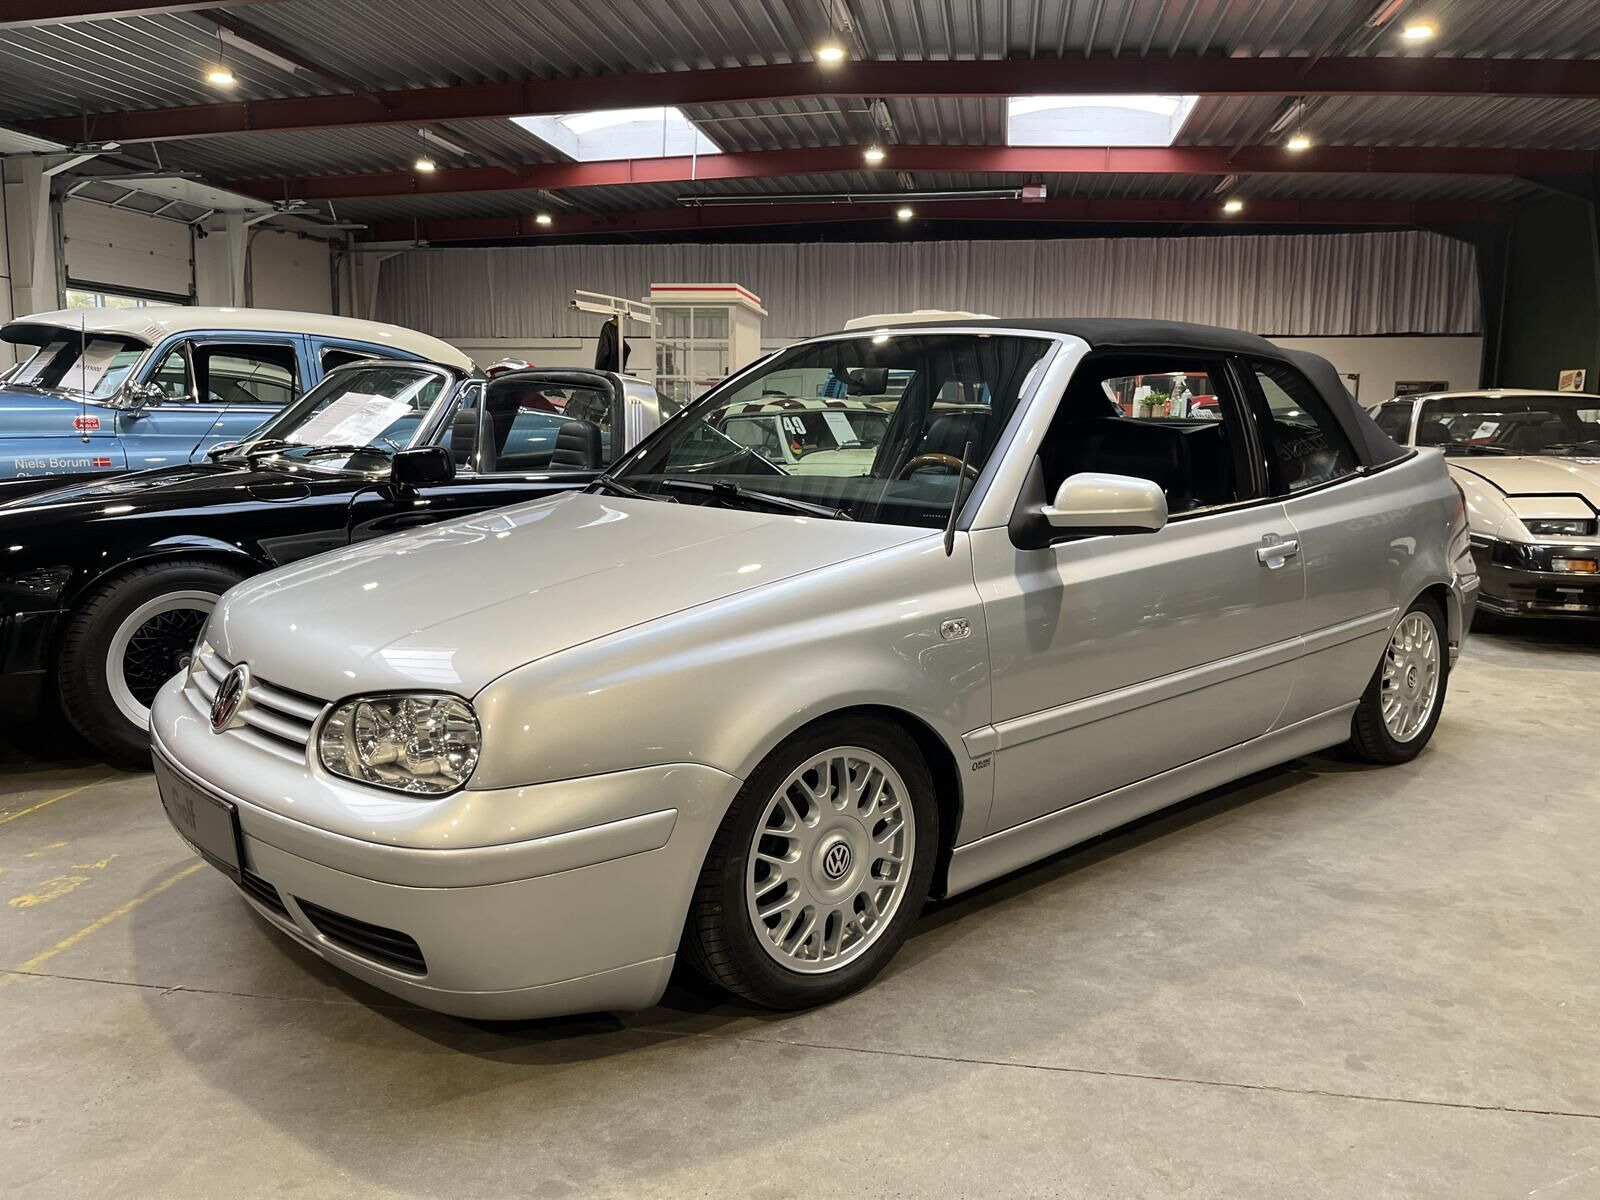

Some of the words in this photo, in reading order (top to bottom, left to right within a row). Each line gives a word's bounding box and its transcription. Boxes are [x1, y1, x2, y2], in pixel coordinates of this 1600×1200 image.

[782, 416, 807, 435] 49
[15, 457, 46, 469] Niels
[49, 457, 91, 469] Borum
